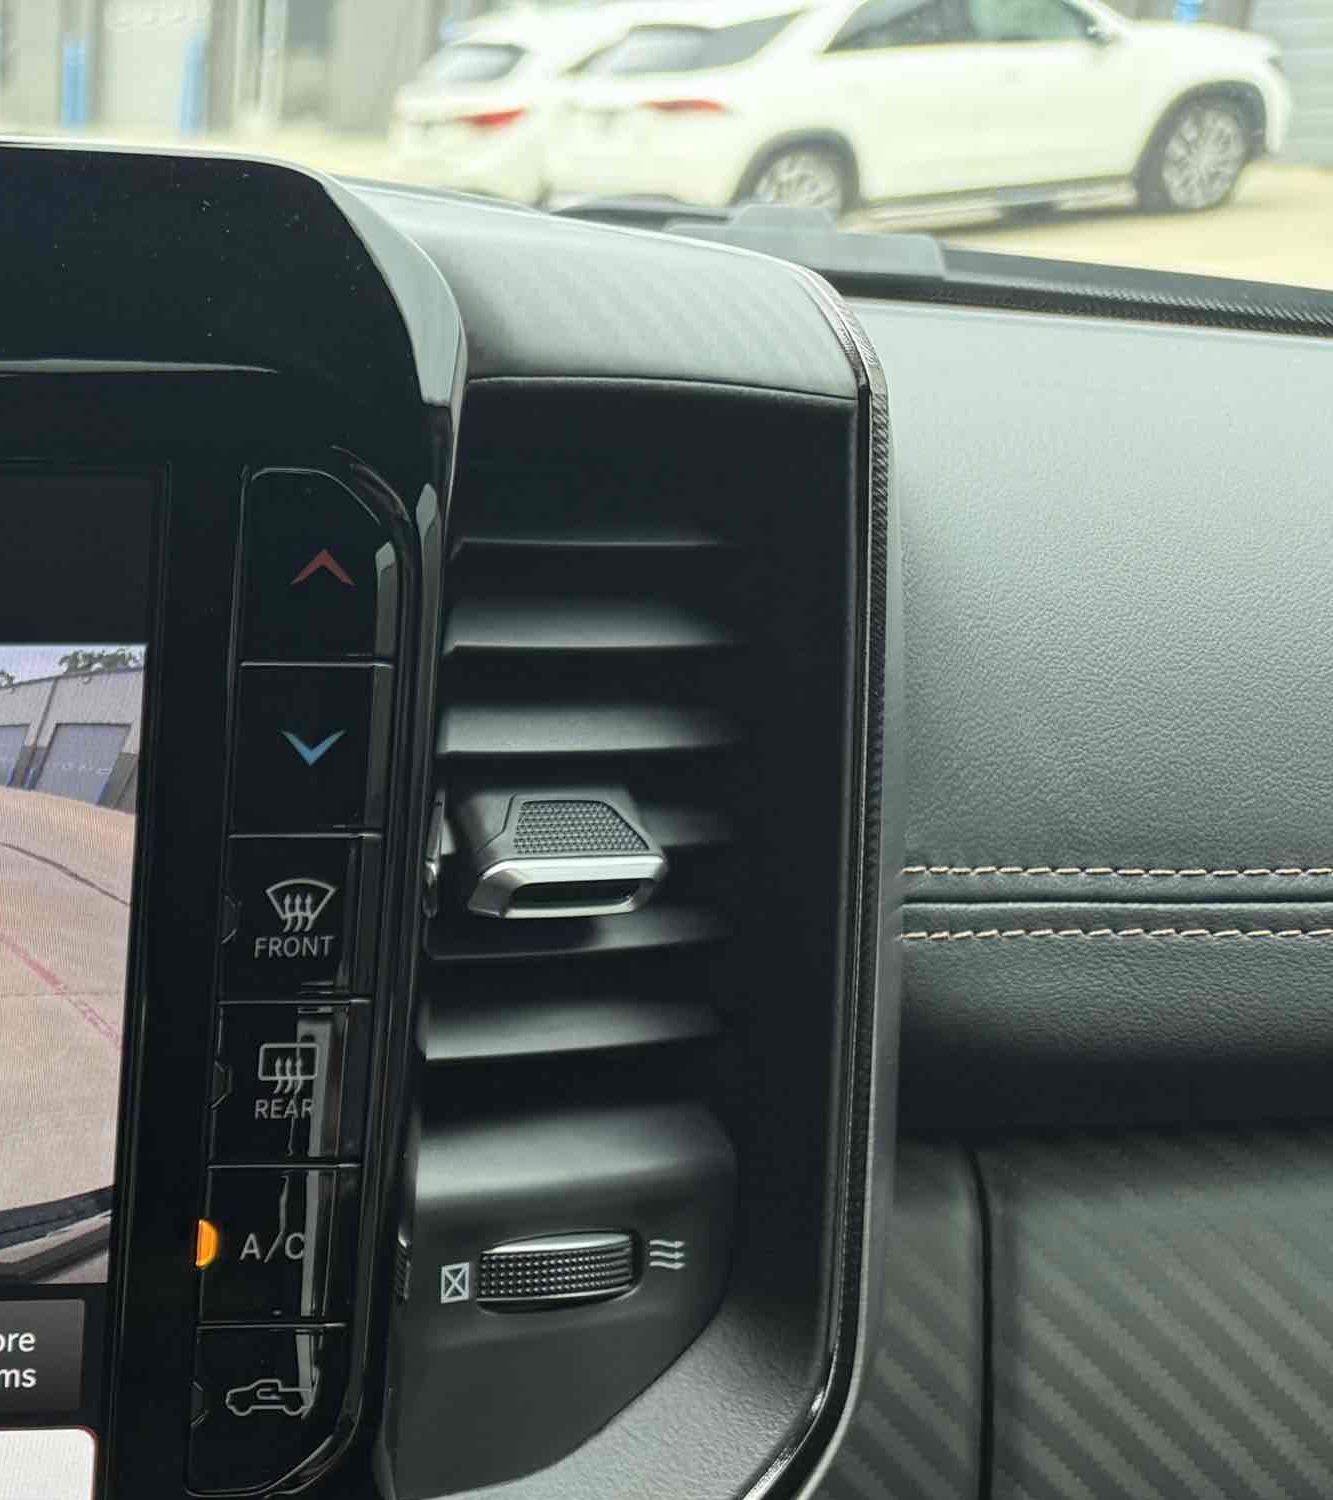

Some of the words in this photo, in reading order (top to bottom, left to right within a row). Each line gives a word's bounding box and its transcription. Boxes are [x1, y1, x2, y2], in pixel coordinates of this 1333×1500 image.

[254, 936, 334, 959] FRONT
[254, 1099, 314, 1119] REAR
[240, 1231, 307, 1262] A/C
